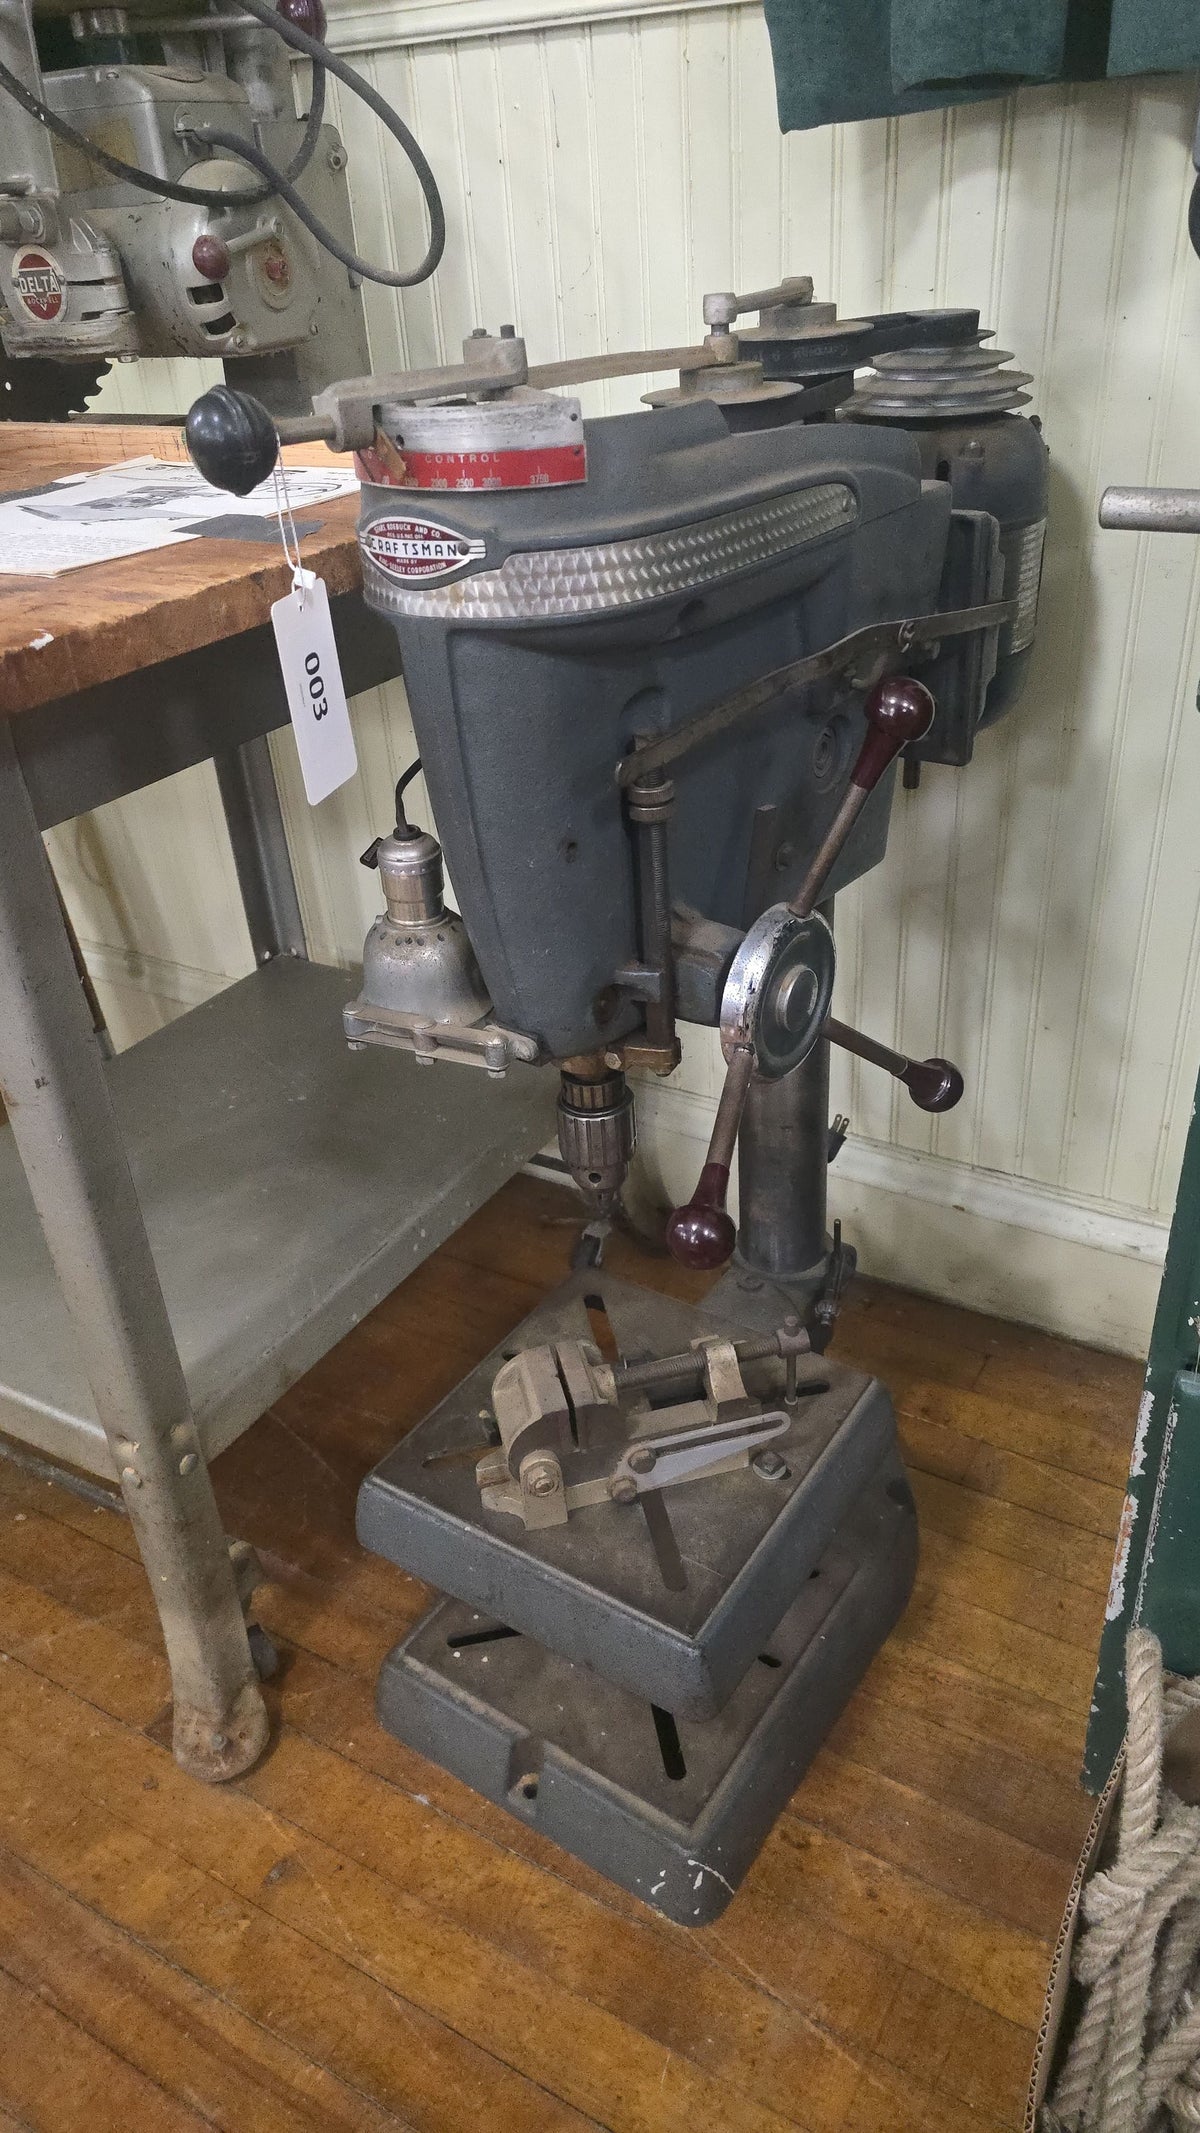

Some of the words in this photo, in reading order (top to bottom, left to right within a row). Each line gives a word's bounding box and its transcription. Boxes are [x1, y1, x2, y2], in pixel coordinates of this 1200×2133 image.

[19, 275, 58, 293] DELTA
[425, 453, 500, 464] CONTROL
[415, 525, 428, 535] AND
[431, 530, 442, 539] CO.
[371, 538, 457, 556] CRAFTSMAN
[407, 562, 447, 574] CORPORATION
[305, 652, 328, 721] 003
